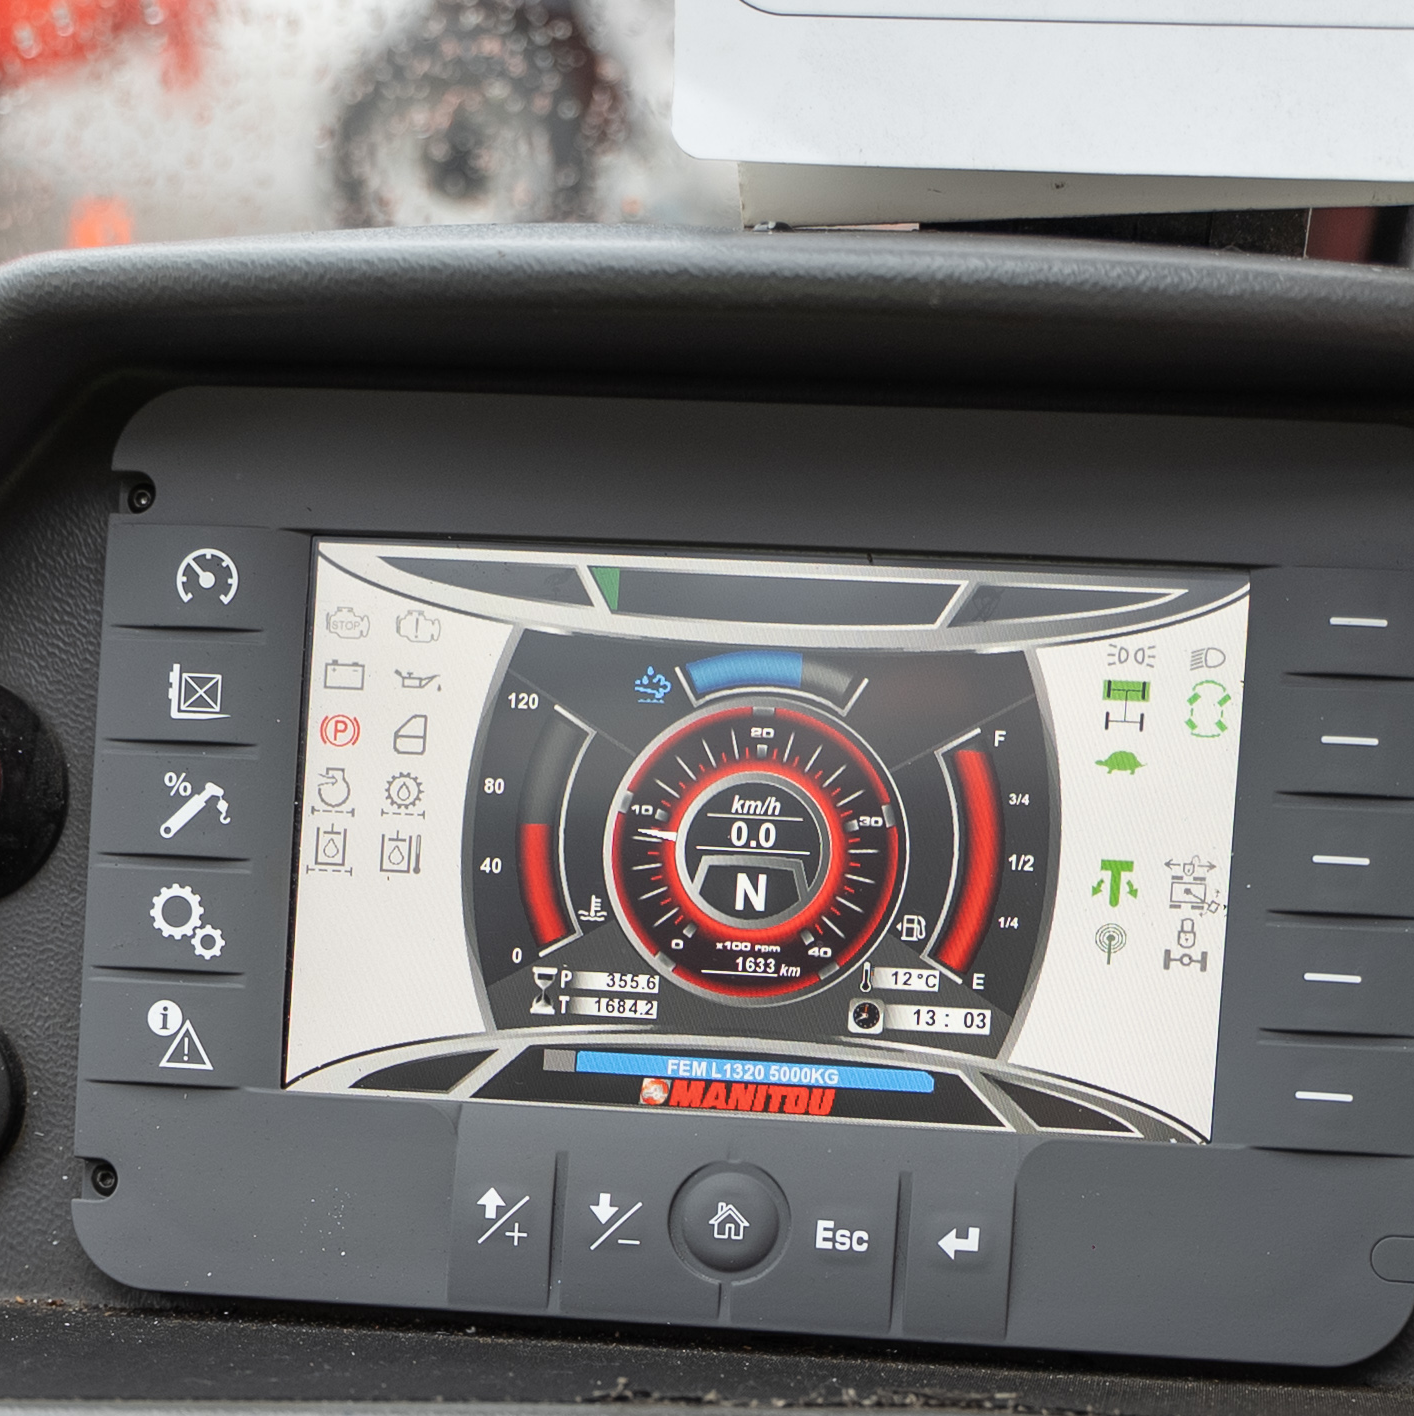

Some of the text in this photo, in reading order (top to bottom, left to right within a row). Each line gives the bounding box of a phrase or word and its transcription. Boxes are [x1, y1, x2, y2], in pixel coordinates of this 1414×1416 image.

[331, 620, 361, 631] STOP
[507, 692, 539, 710] 120
[750, 727, 775, 739] 20
[993, 730, 1007, 747] F
[483, 777, 505, 795] 80
[731, 795, 782, 815] km/h
[1008, 792, 1030, 806] 3/4
[631, 804, 654, 816] 10
[858, 816, 884, 828] 30
[729, 821, 777, 848] 0.0
[480, 857, 503, 874] 40
[1008, 854, 1035, 871] 1/2
[734, 872, 768, 912] N
[998, 916, 1019, 929] 1/4
[671, 939, 684, 950] 0
[715, 941, 781, 953] x100 rpm
[807, 947, 832, 958] 40
[511, 947, 523, 964] 0
[735, 956, 801, 977] 1633 km
[560, 969, 656, 990] P 355.6
[972, 973, 986, 990] E
[558, 995, 654, 1016] T 1684.2
[667, 1059, 839, 1085] FEM L1320 5000KG
[668, 1079, 836, 1116] MANITOU
[815, 1220, 869, 1253] Esc
